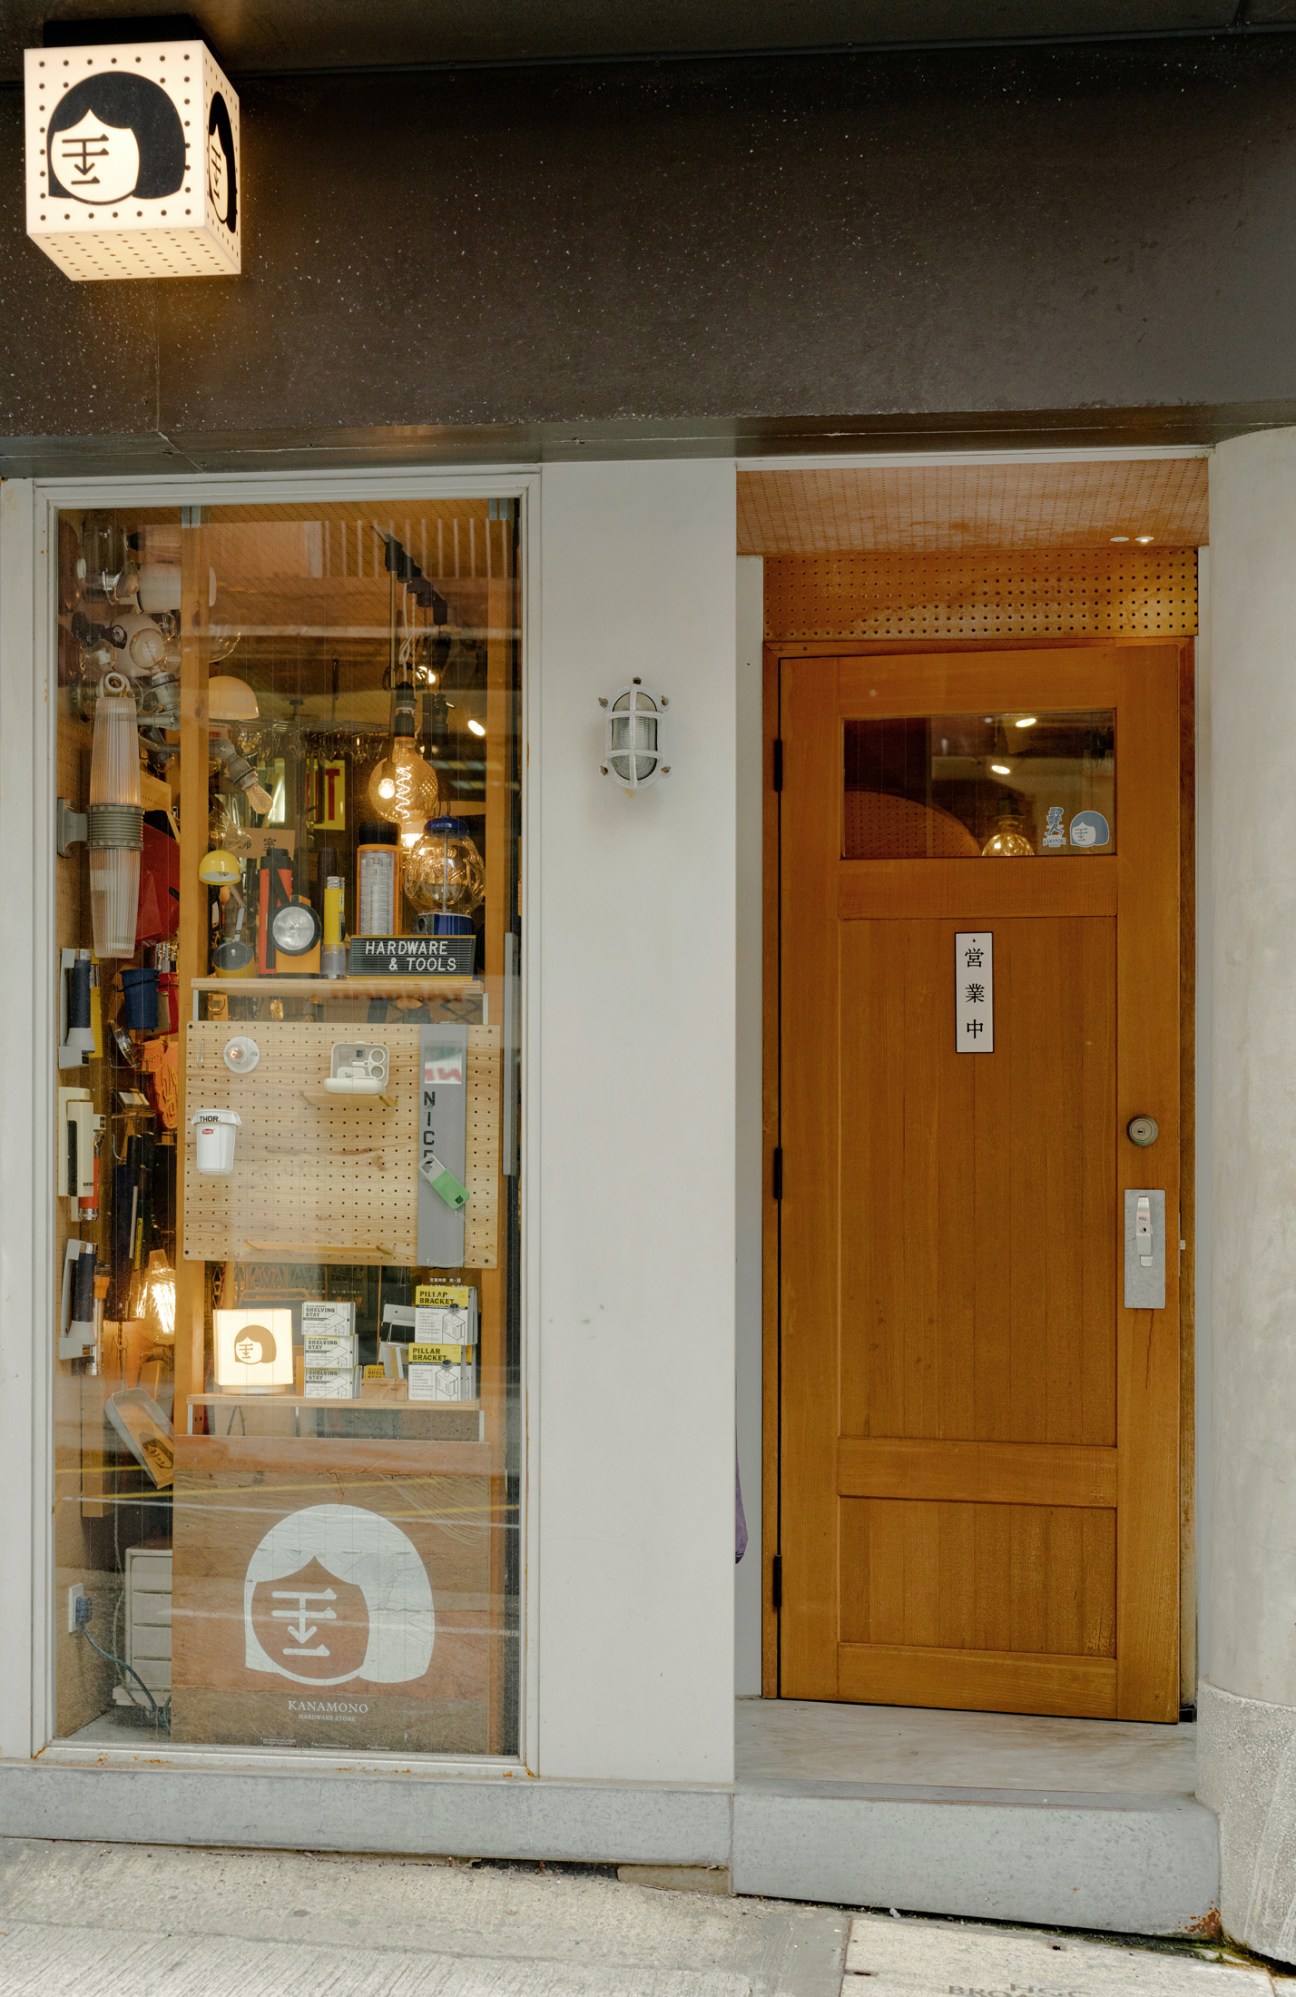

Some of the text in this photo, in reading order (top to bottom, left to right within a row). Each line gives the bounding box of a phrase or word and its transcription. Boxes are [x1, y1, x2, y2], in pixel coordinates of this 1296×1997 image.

[365, 940, 448, 955] HARDWARE
[388, 957, 457, 971] & TOOLS
[964, 947, 985, 1039] 営業中
[419, 1297, 455, 1305] BRACKET
[412, 1347, 441, 1355] PILLAR
[412, 1354, 448, 1362] BRACKET
[288, 1700, 369, 1714] KANAMONO
